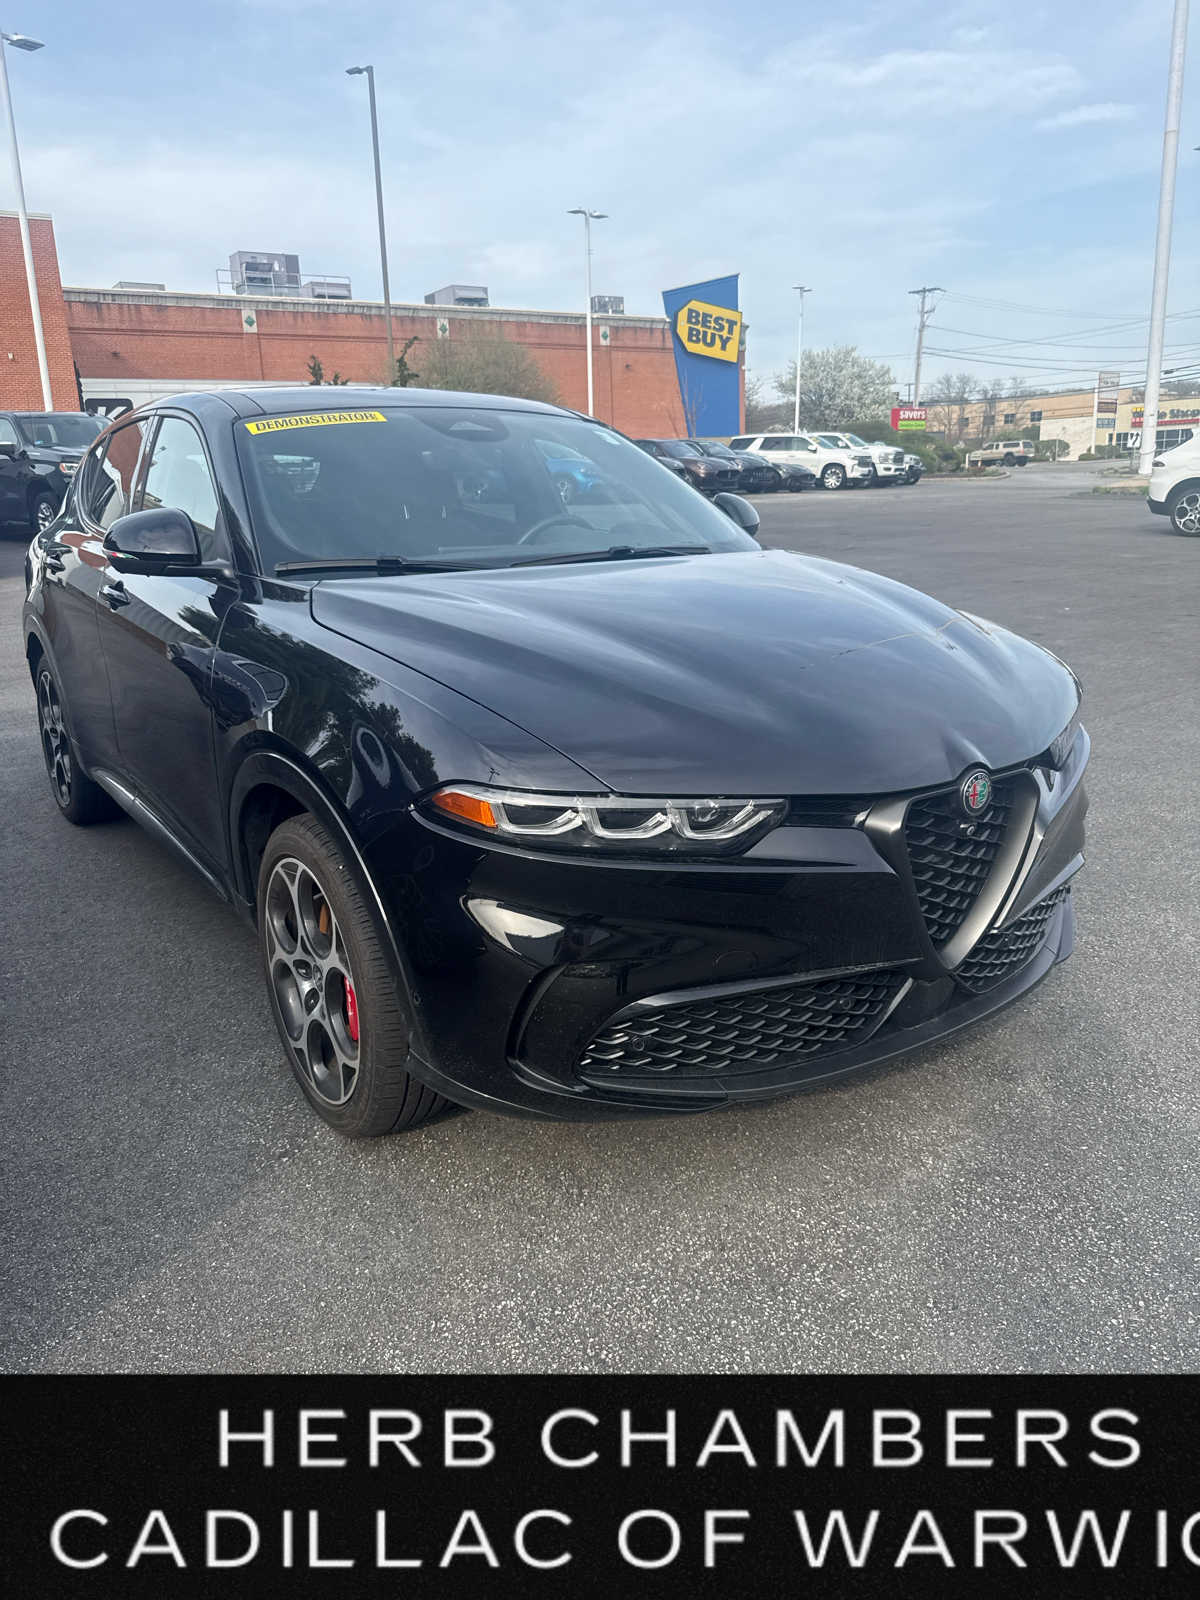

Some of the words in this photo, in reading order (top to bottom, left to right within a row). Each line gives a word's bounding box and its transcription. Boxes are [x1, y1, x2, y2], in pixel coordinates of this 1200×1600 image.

[687, 308, 737, 335] BEST
[687, 326, 732, 351] BUY
[256, 412, 376, 431] DEMONSTRATOR
[900, 410, 926, 419] savers
